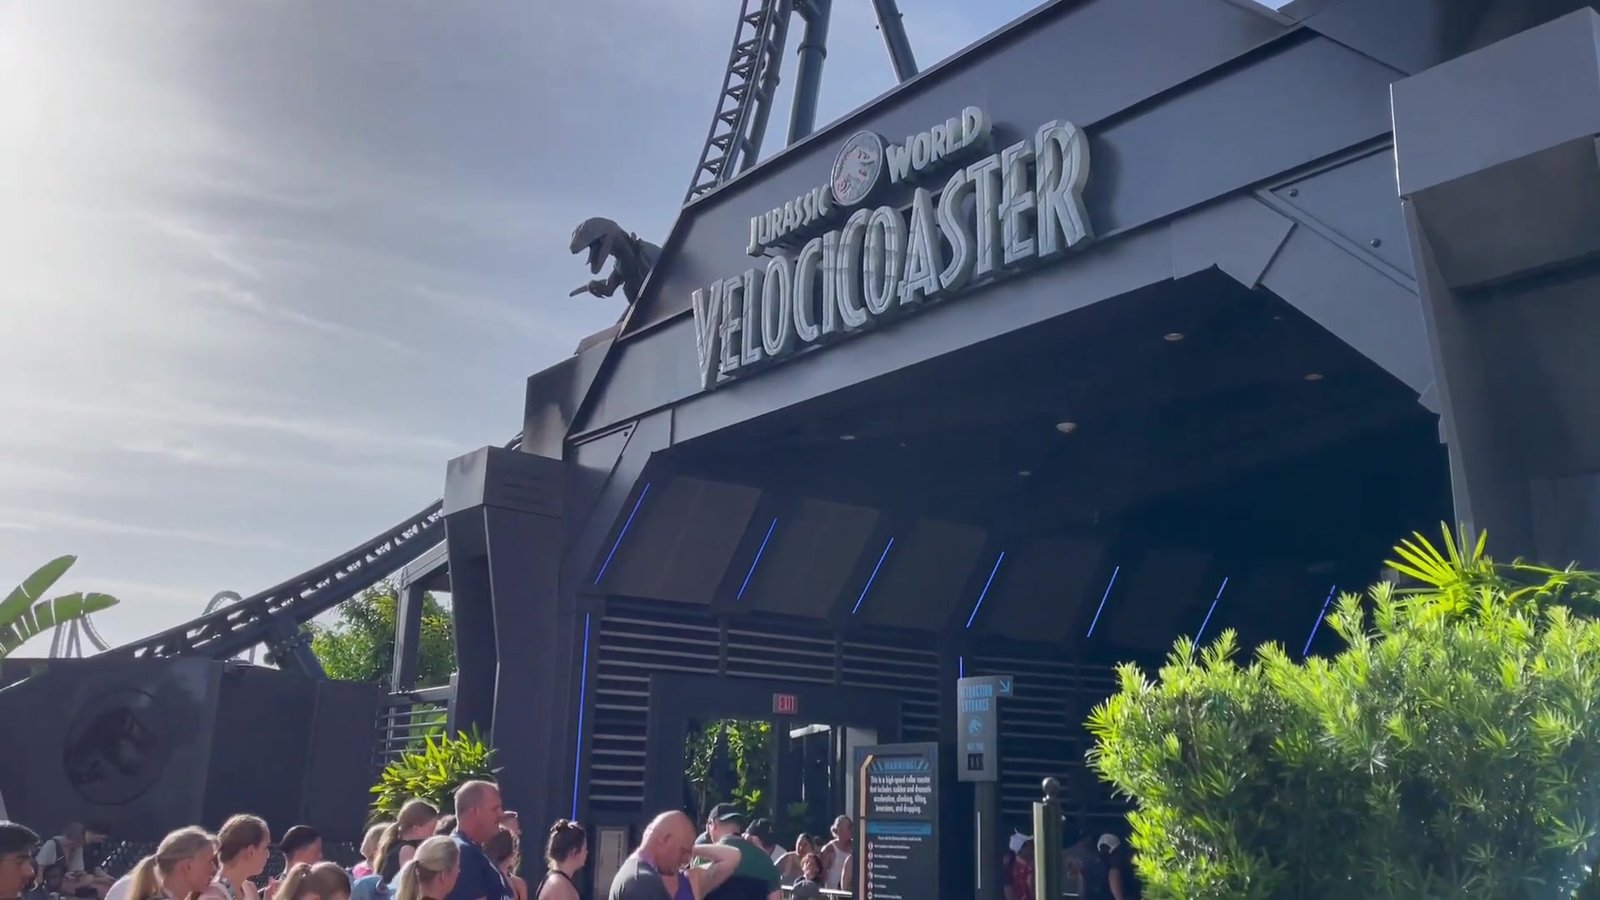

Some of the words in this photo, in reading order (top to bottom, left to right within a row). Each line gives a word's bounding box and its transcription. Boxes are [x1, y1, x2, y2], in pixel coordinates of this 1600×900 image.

[746, 184, 834, 256] JURASSIC
[885, 106, 993, 184] WORLD
[691, 119, 1093, 390] VELOCICOASTER
[778, 695, 794, 711] EXIT
[961, 698, 990, 712] ENTRANCE
